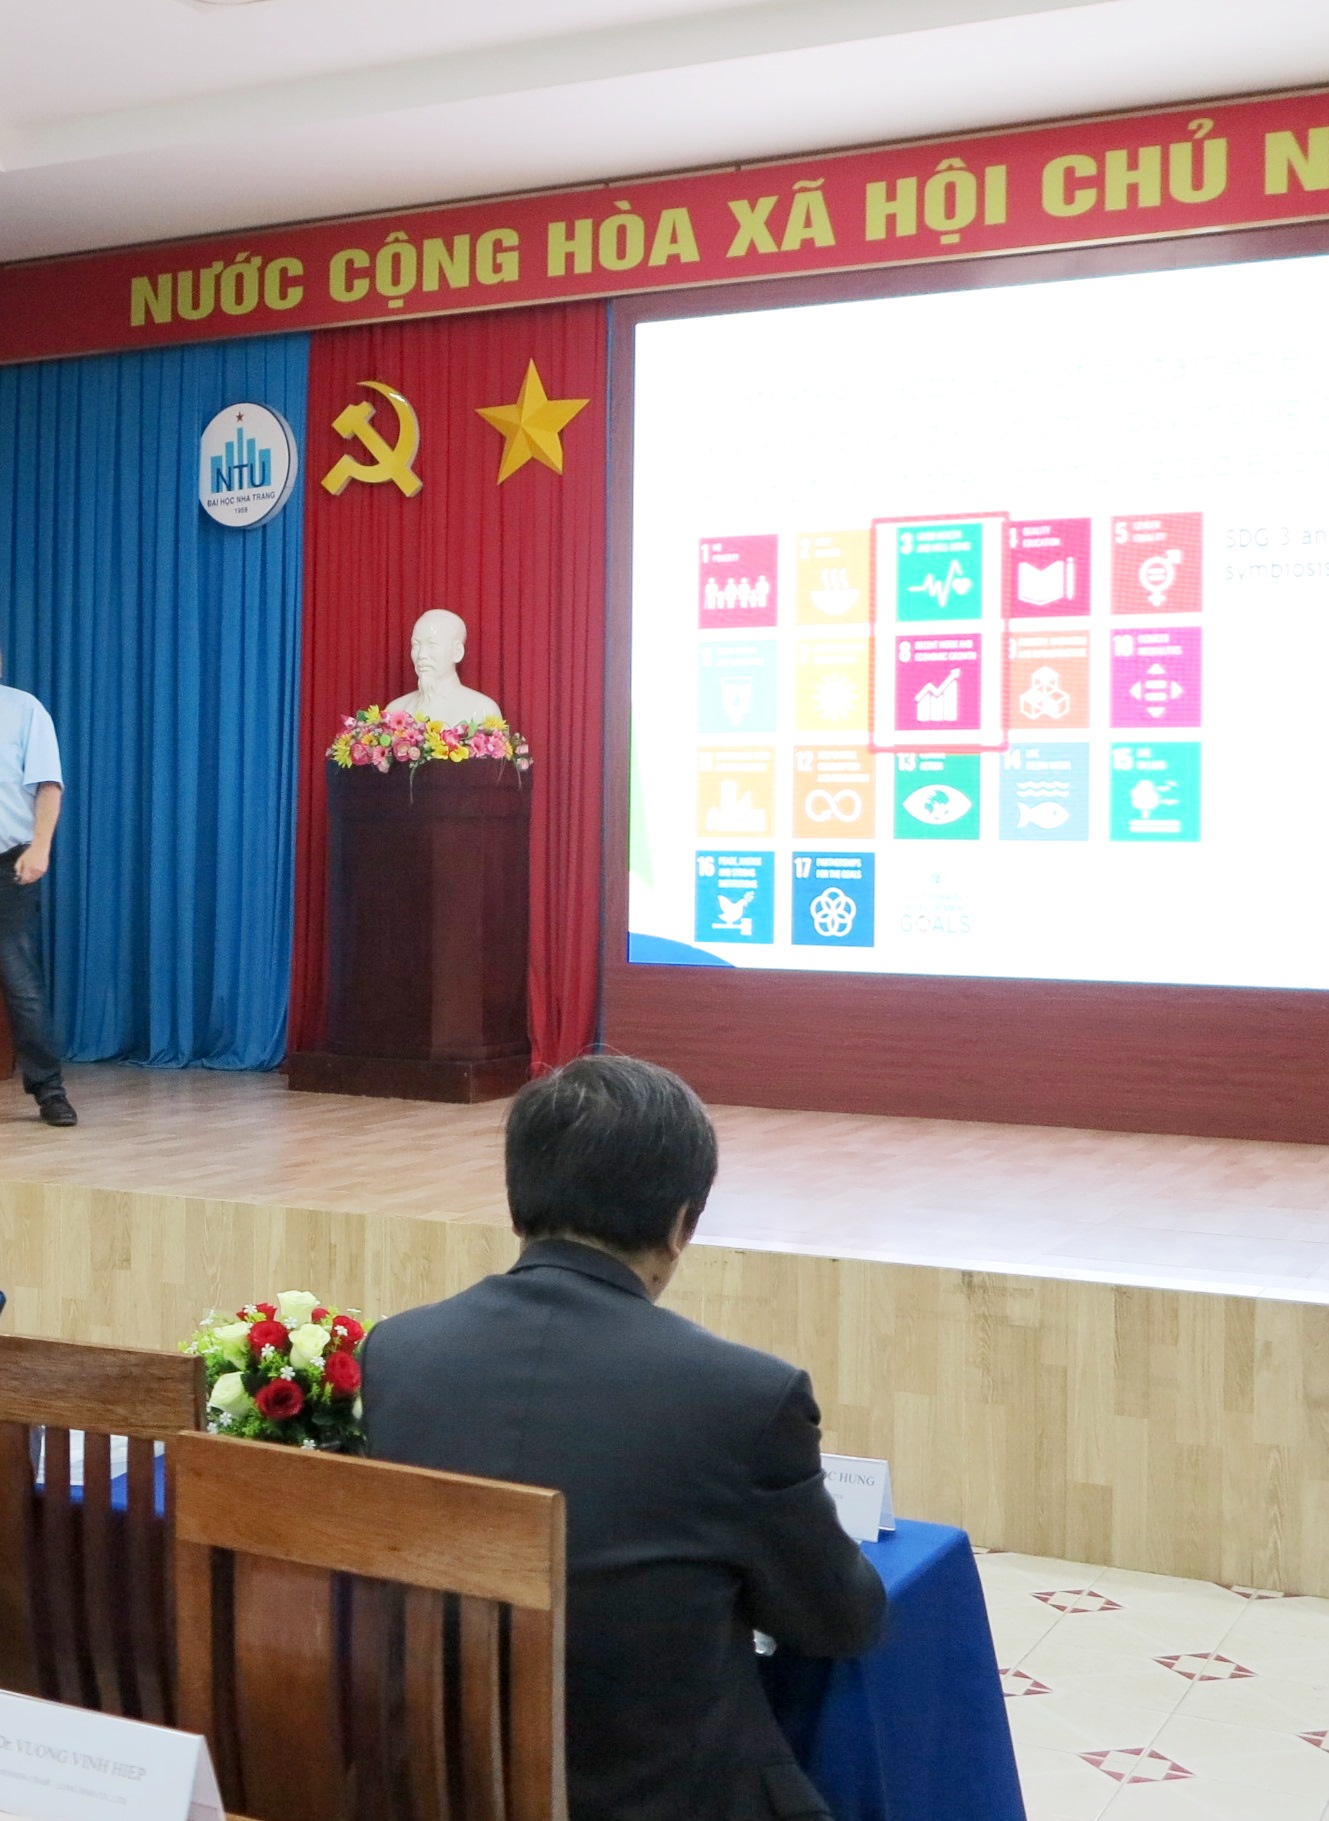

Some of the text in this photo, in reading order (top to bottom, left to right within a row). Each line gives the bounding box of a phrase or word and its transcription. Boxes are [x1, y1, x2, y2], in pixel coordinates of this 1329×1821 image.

[129, 251, 304, 327] NƯỚC
[328, 227, 520, 309] CỘNG
[546, 200, 700, 277] HÒA
[726, 177, 836, 258] XÃ
[864, 156, 1007, 245] HỘI
[1041, 117, 1228, 217] CHỦ
[215, 461, 266, 493] NTU
[236, 495, 251, 503] NHA
[252, 491, 276, 501] TRANG
[900, 532, 913, 555] 3
[1115, 521, 1128, 544] 5
[1226, 527, 1269, 548] SDG
[1280, 526, 1290, 546] 3
[700, 543, 709, 563] 1
[898, 641, 911, 663] 8
[1112, 634, 1133, 657] 10
[796, 752, 813, 772] 12
[897, 752, 916, 772] 13
[1112, 748, 1133, 771] 15
[697, 856, 715, 877] 16
[794, 857, 812, 879] 17
[839, 1472, 875, 1486] HUNG
[72, 1752, 110, 1775] VINH
[111, 1761, 147, 1781] HIEP
